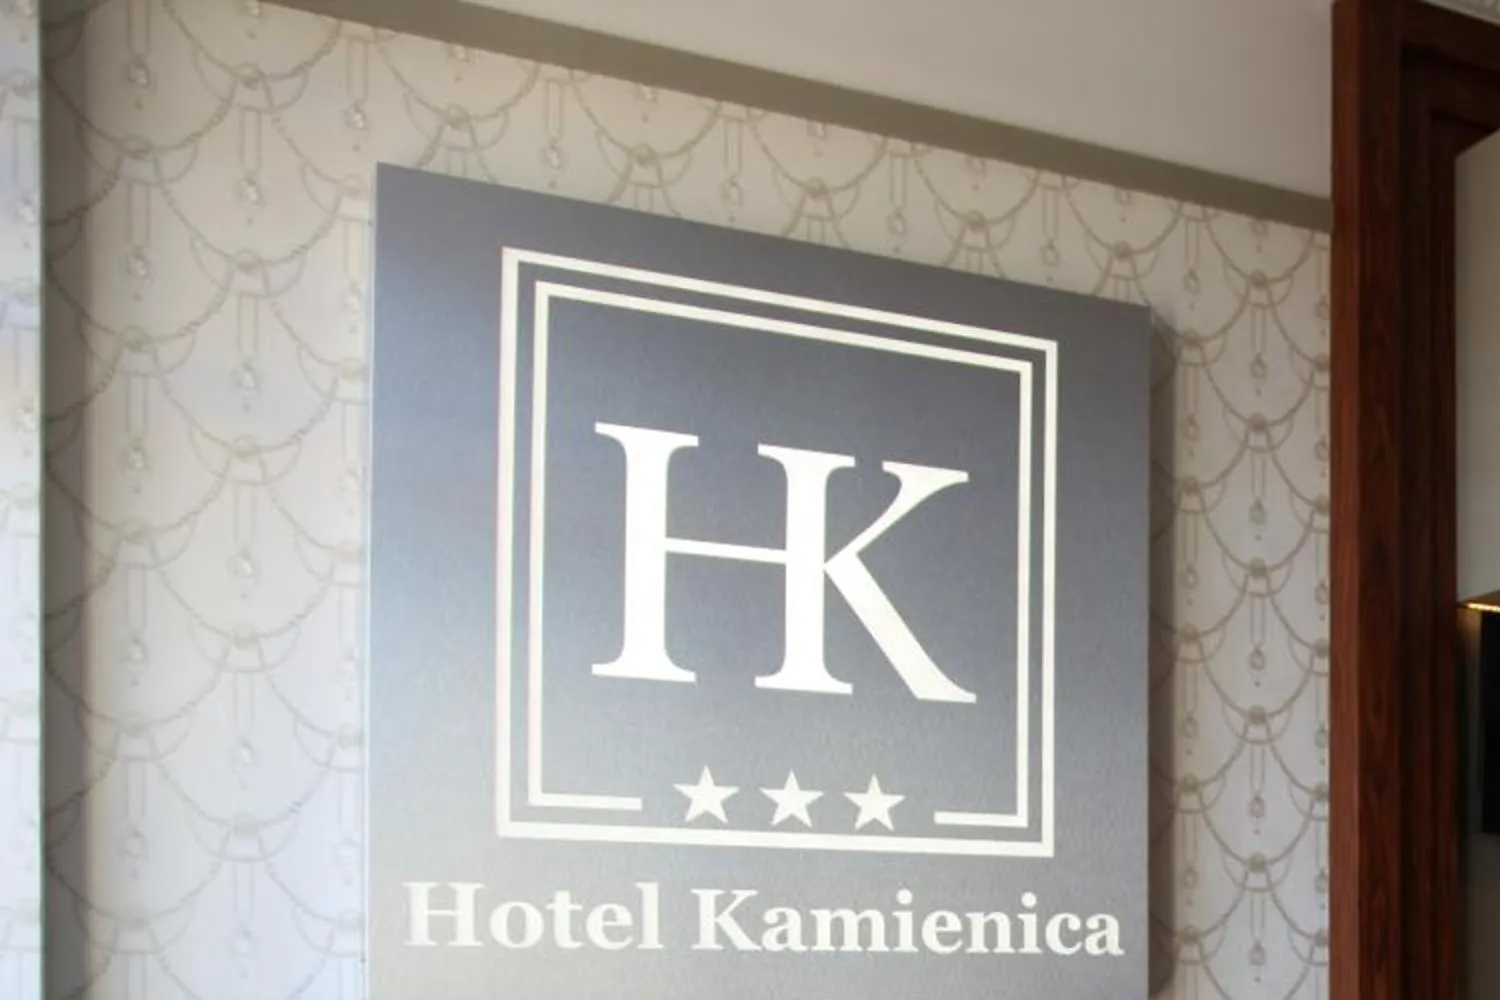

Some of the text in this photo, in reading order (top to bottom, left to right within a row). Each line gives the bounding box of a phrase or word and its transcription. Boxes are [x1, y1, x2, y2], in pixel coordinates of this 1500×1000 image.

[591, 421, 977, 704] HK
[402, 880, 1126, 956] Hotel Kamienica
